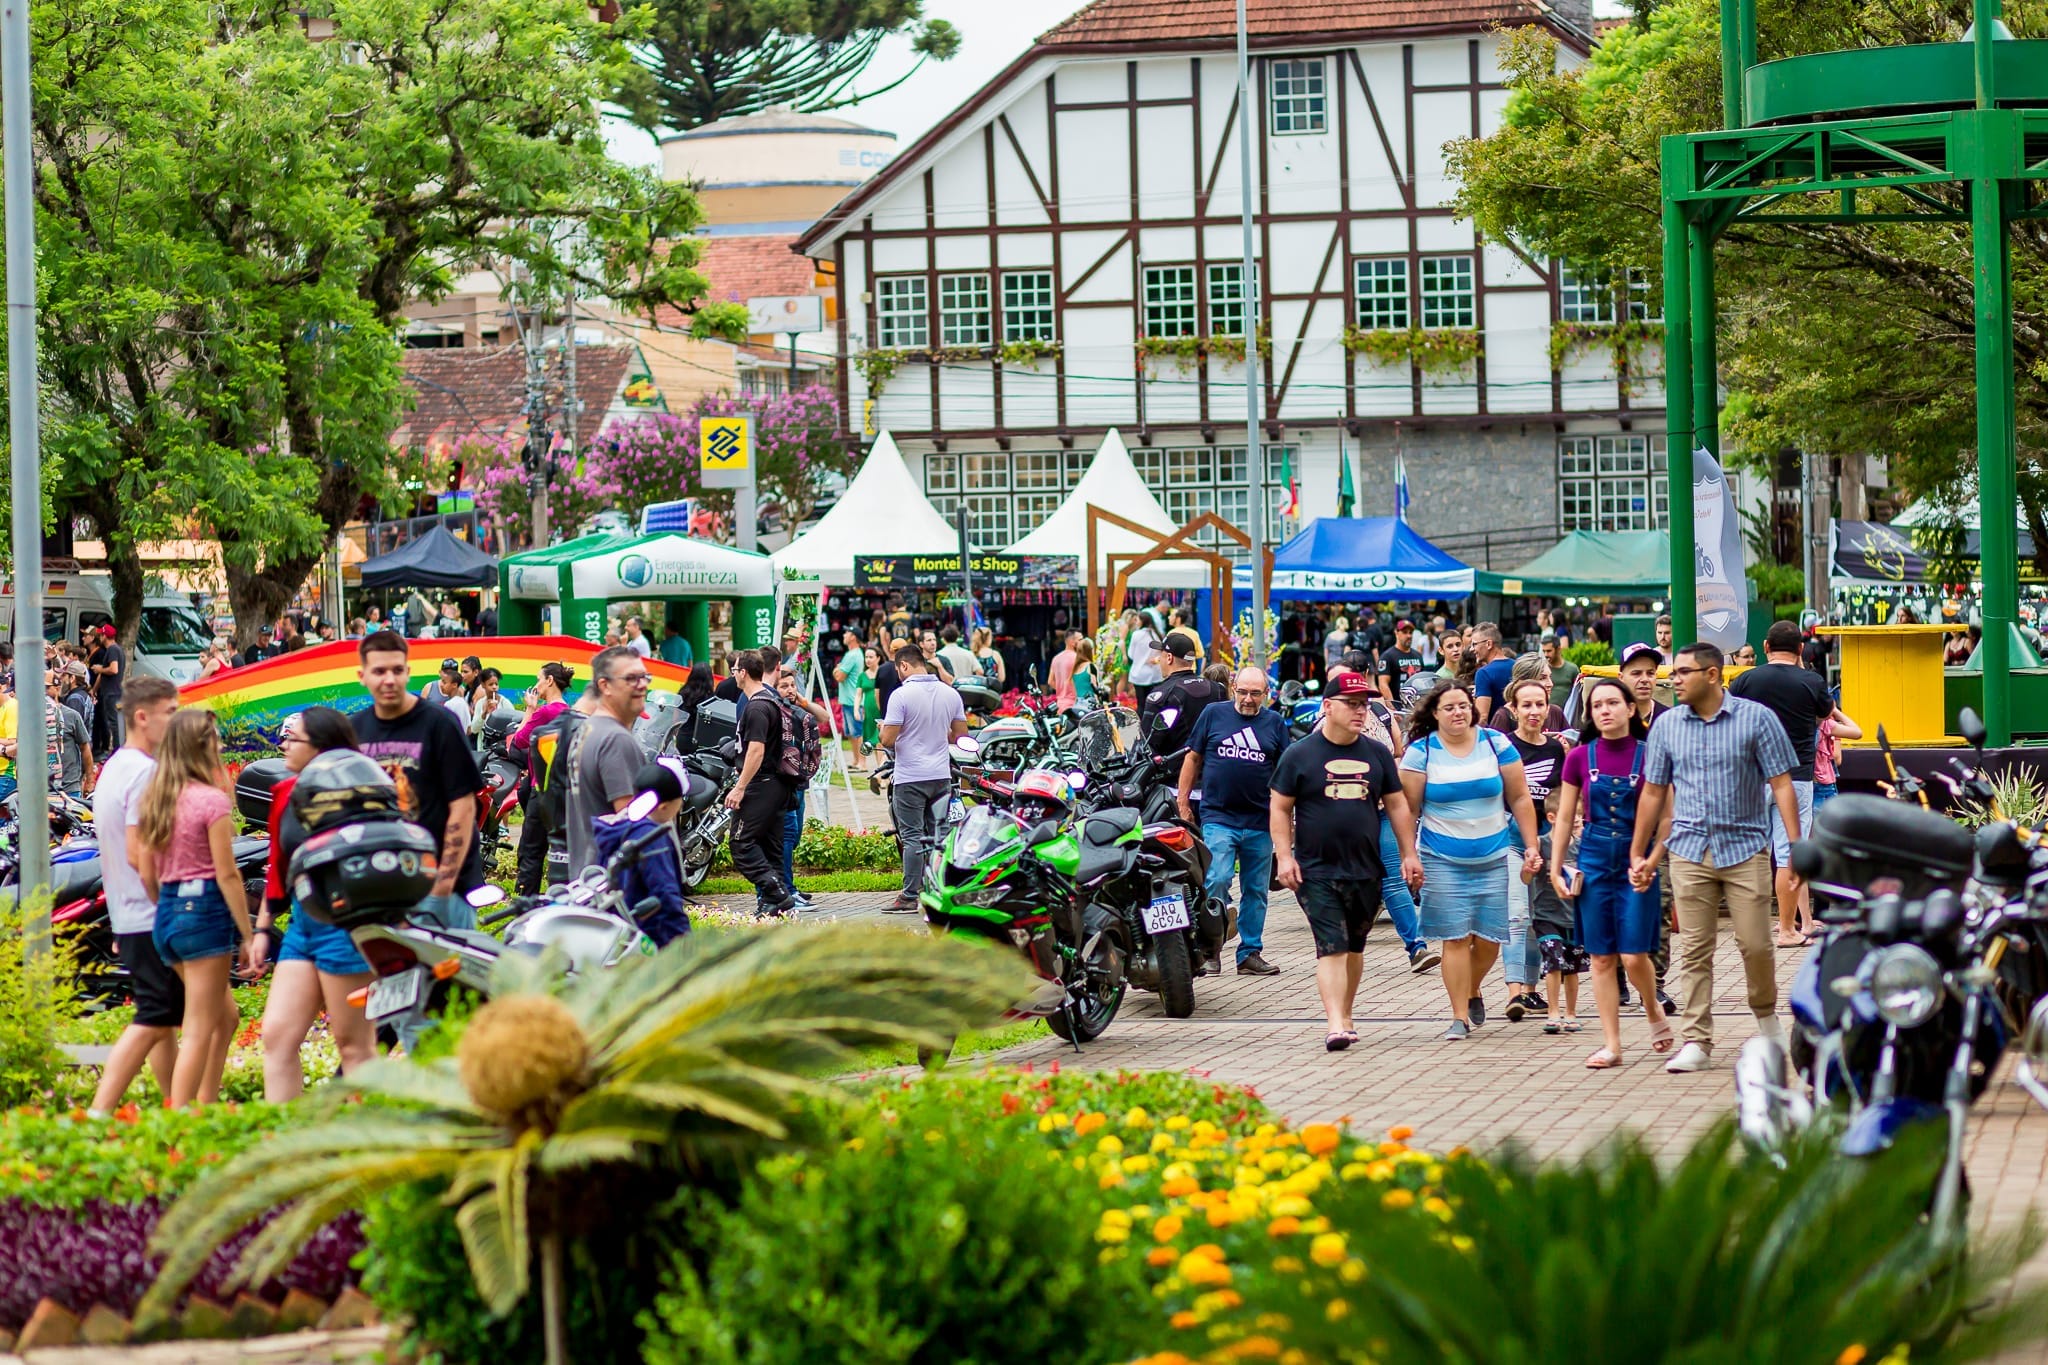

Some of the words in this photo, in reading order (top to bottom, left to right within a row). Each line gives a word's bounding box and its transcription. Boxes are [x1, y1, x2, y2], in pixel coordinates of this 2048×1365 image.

[913, 556, 980, 571] Monteis
[982, 557, 1018, 574] Shop
[656, 570, 738, 585] natureza
[756, 608, 771, 646] 5083
[1217, 744, 1266, 762] adidas
[1152, 903, 1177, 918] JAQ
[1151, 914, 1183, 930] 6C94
